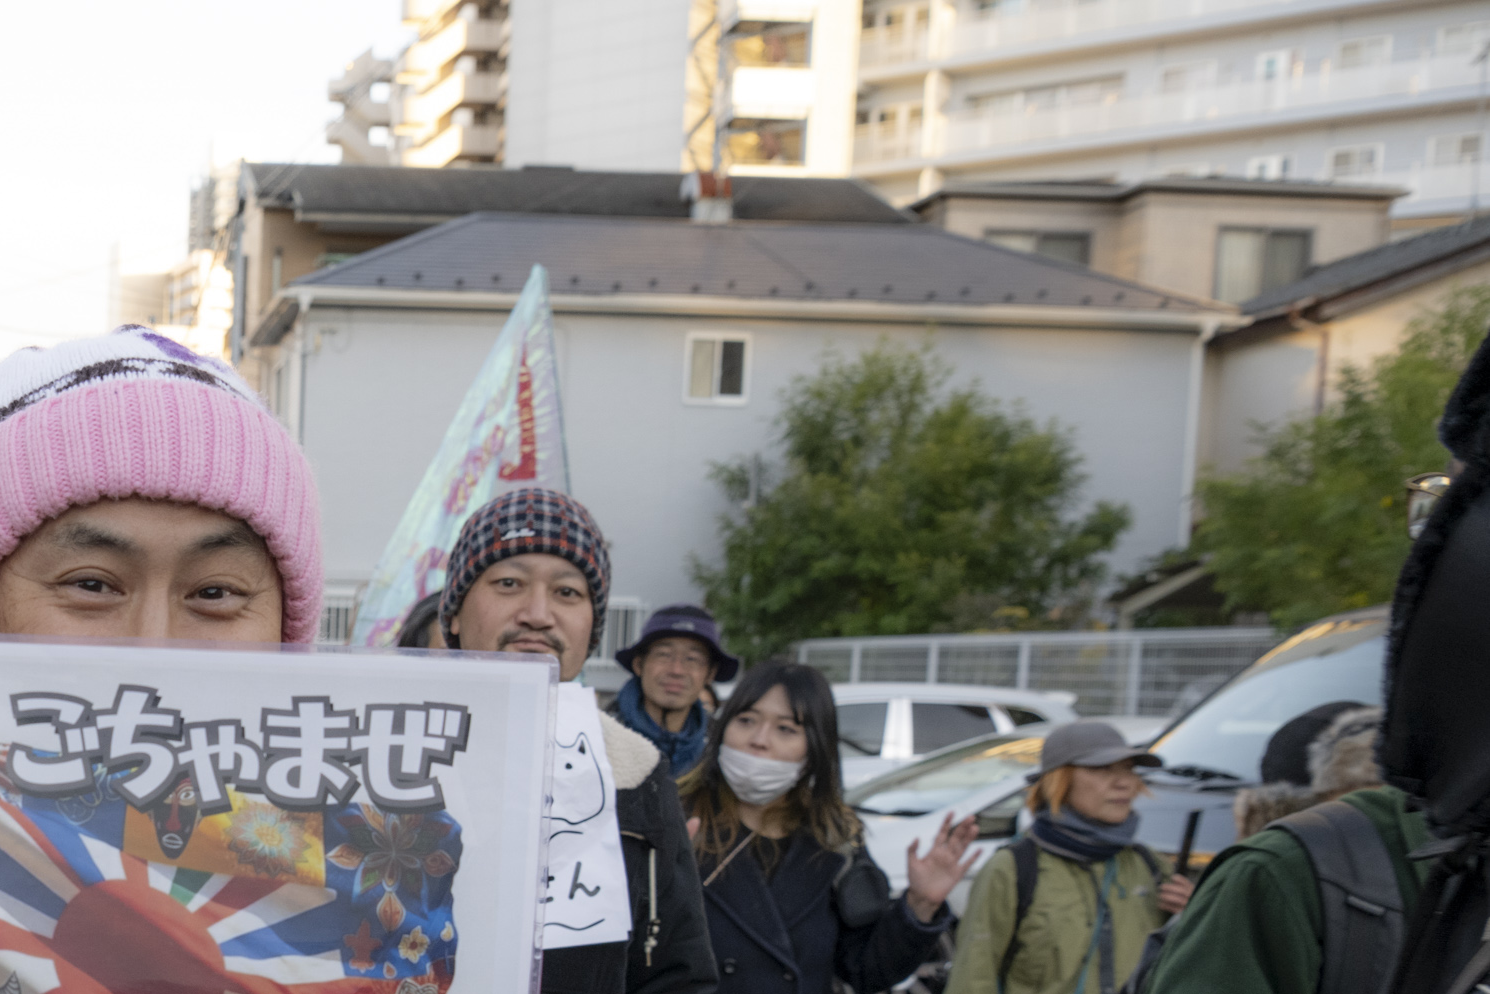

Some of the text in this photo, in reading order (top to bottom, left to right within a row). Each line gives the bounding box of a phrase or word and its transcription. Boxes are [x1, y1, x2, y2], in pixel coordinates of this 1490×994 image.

[10, 684, 470, 815] ごちゃまぜ
